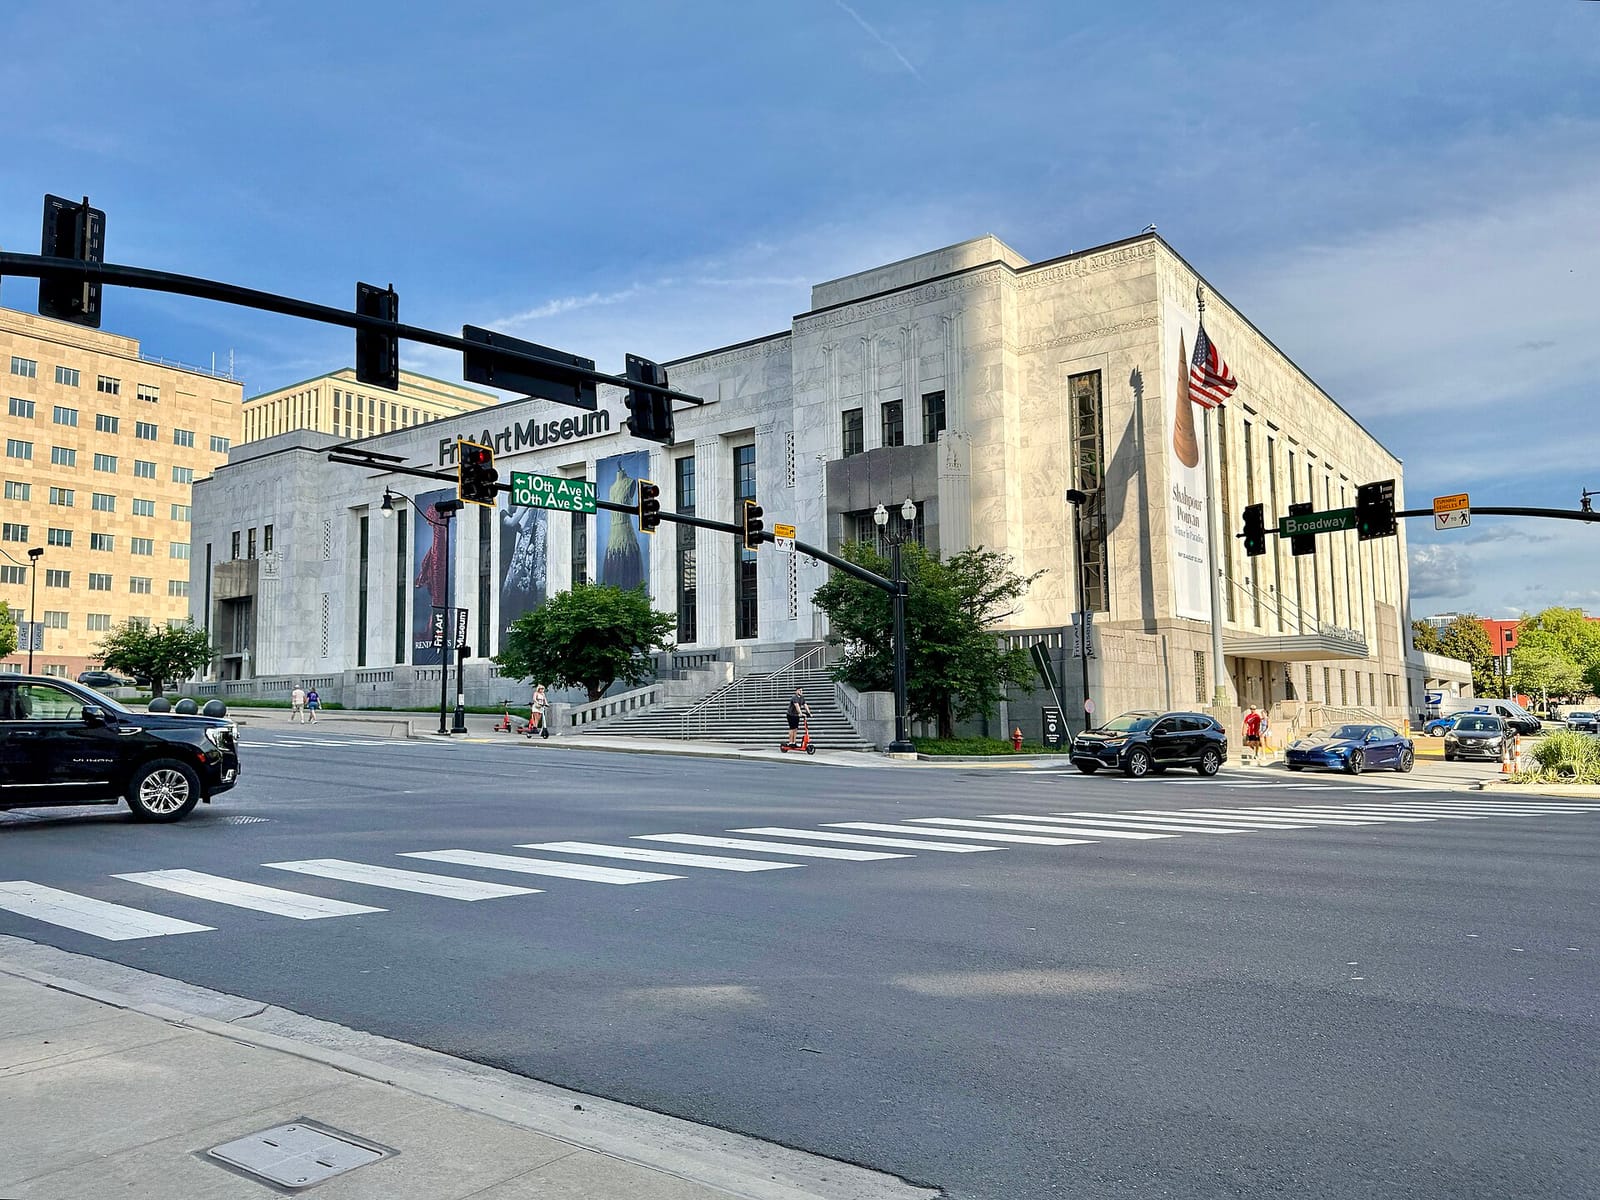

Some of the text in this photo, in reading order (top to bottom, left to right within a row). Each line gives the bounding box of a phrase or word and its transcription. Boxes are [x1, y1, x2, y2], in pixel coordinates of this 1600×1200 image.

[480, 426, 512, 455] Art
[514, 409, 610, 450] Museum
[527, 475, 595, 498] 10th Ave N
[515, 488, 583, 510] 10th Ave S
[1286, 516, 1347, 533] Broadway
